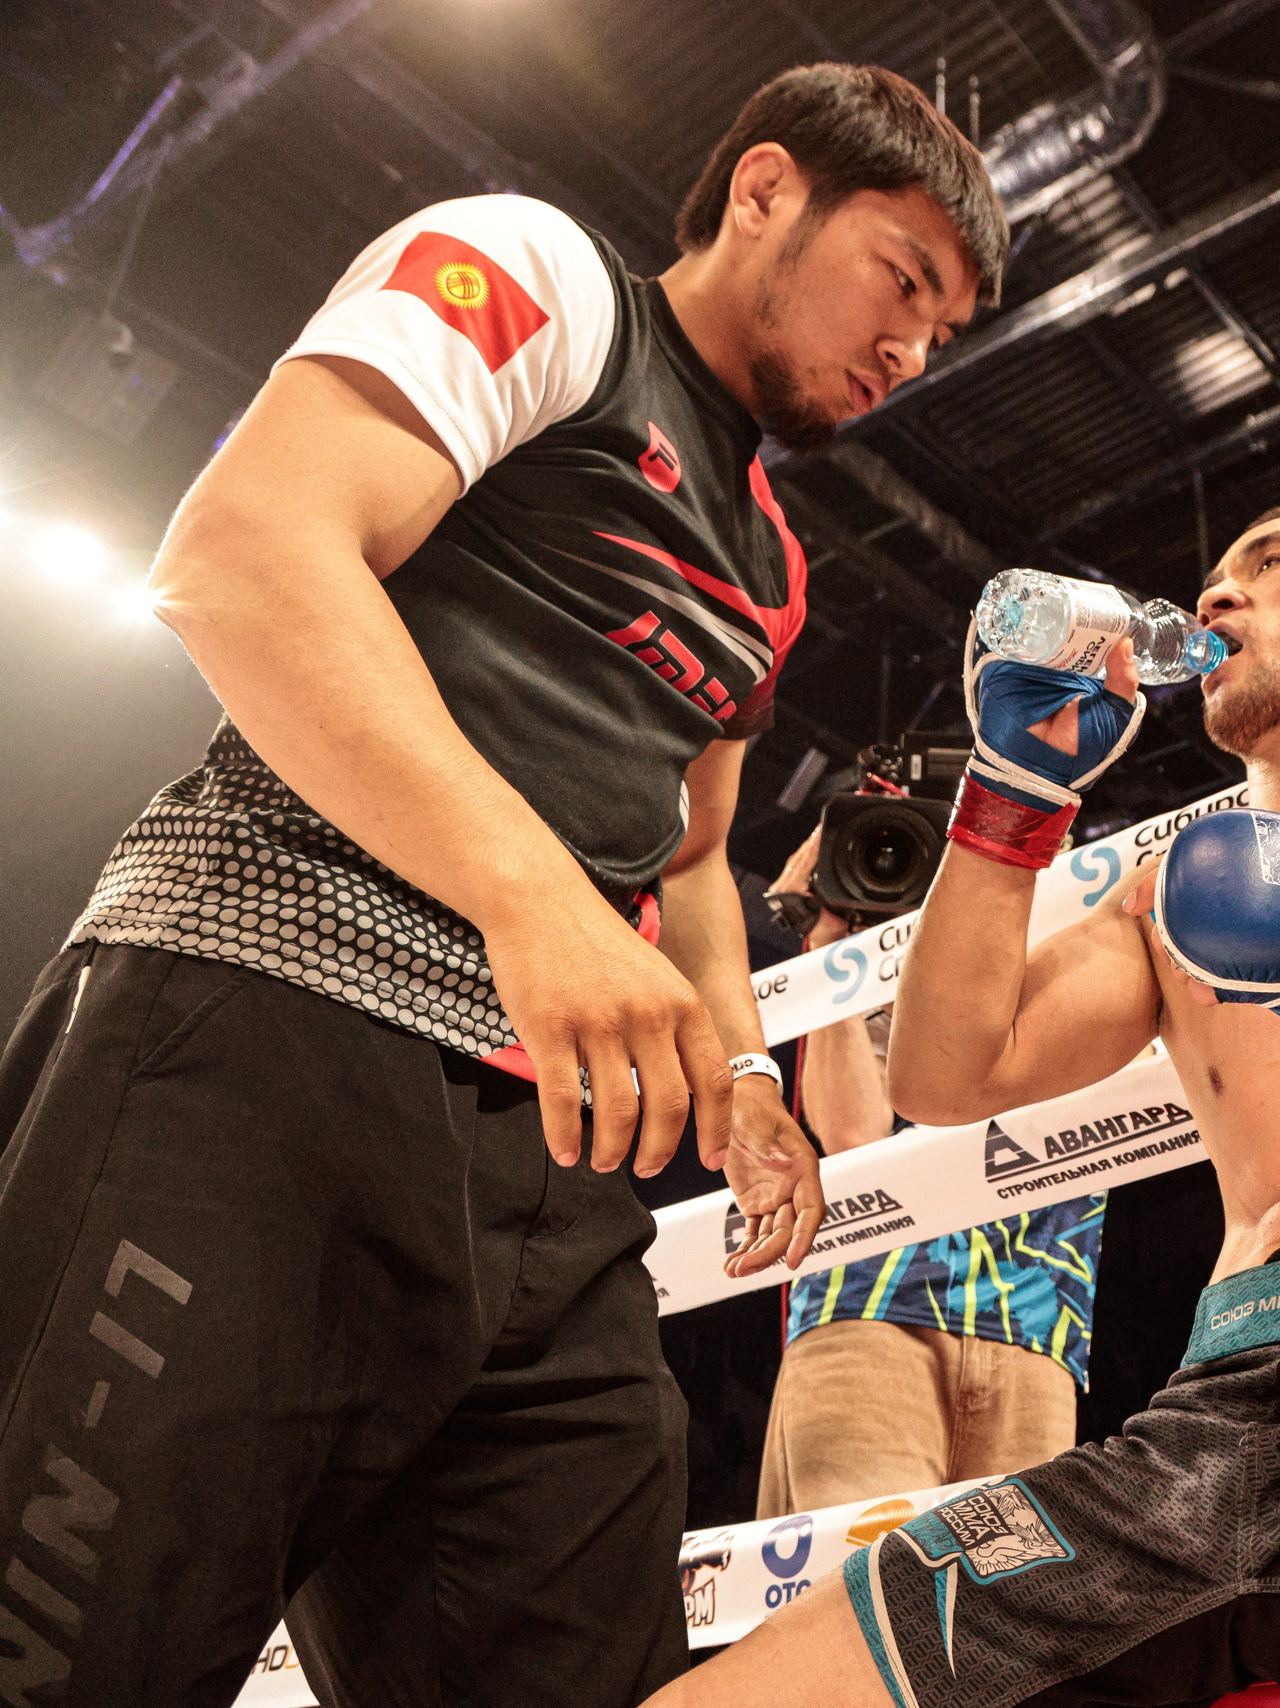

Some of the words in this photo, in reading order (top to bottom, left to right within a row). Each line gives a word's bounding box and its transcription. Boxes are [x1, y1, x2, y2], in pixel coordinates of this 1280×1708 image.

[1044, 1102, 1195, 1159] АВАНГАРД
[997, 1158, 1113, 1199] СТРОИТЕЛЬНАЯ
[1115, 1129, 1201, 1167] КОМПАНИЯ
[836, 1215, 916, 1247] КОМПАНИЯ
[1210, 1301, 1255, 1330] СОЮЗ
[938, 1507, 976, 1547] РОССИИ
[950, 1500, 990, 1540] ММА
[968, 1495, 1009, 1534] СОЮЗ
